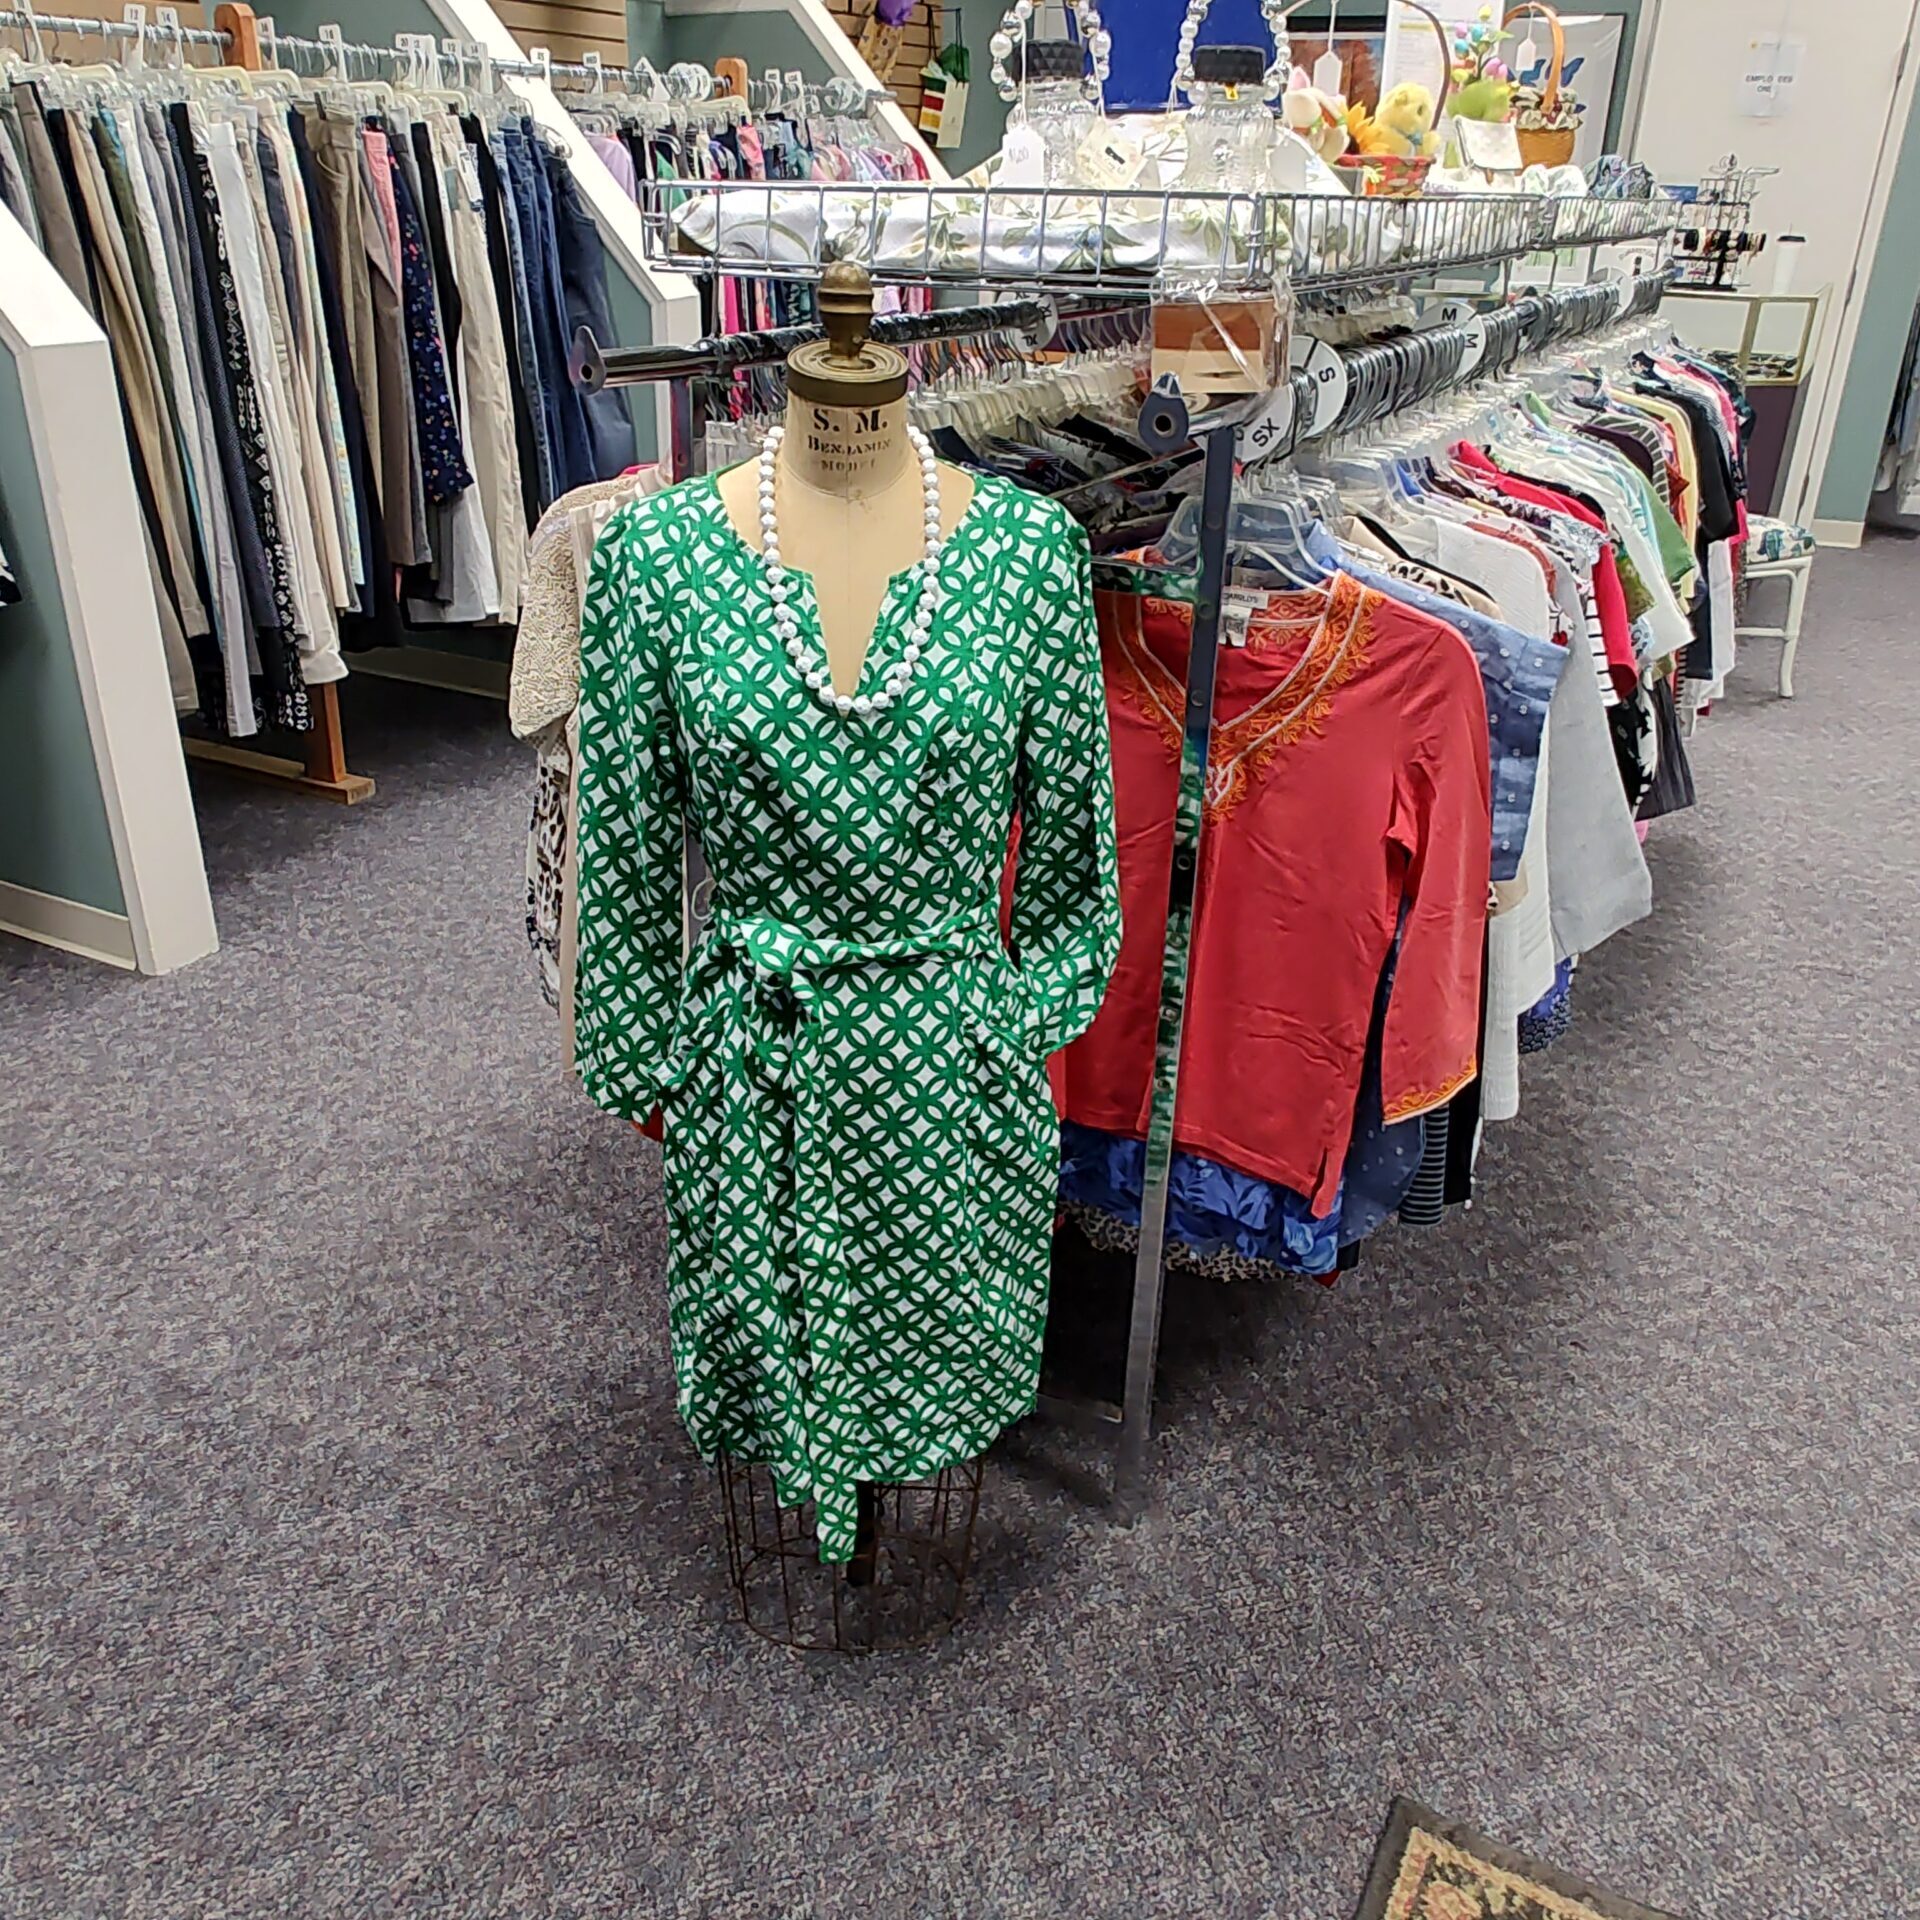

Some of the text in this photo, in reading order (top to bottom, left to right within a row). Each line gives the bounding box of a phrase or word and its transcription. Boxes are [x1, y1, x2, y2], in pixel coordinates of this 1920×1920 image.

[1745, 75, 1793, 83] EMPLOEES
[1441, 307, 1458, 322] M
[1464, 333, 1480, 349] M
[1318, 366, 1336, 384] S
[814, 408, 888, 433] S. M.
[821, 458, 876, 471] MODL
